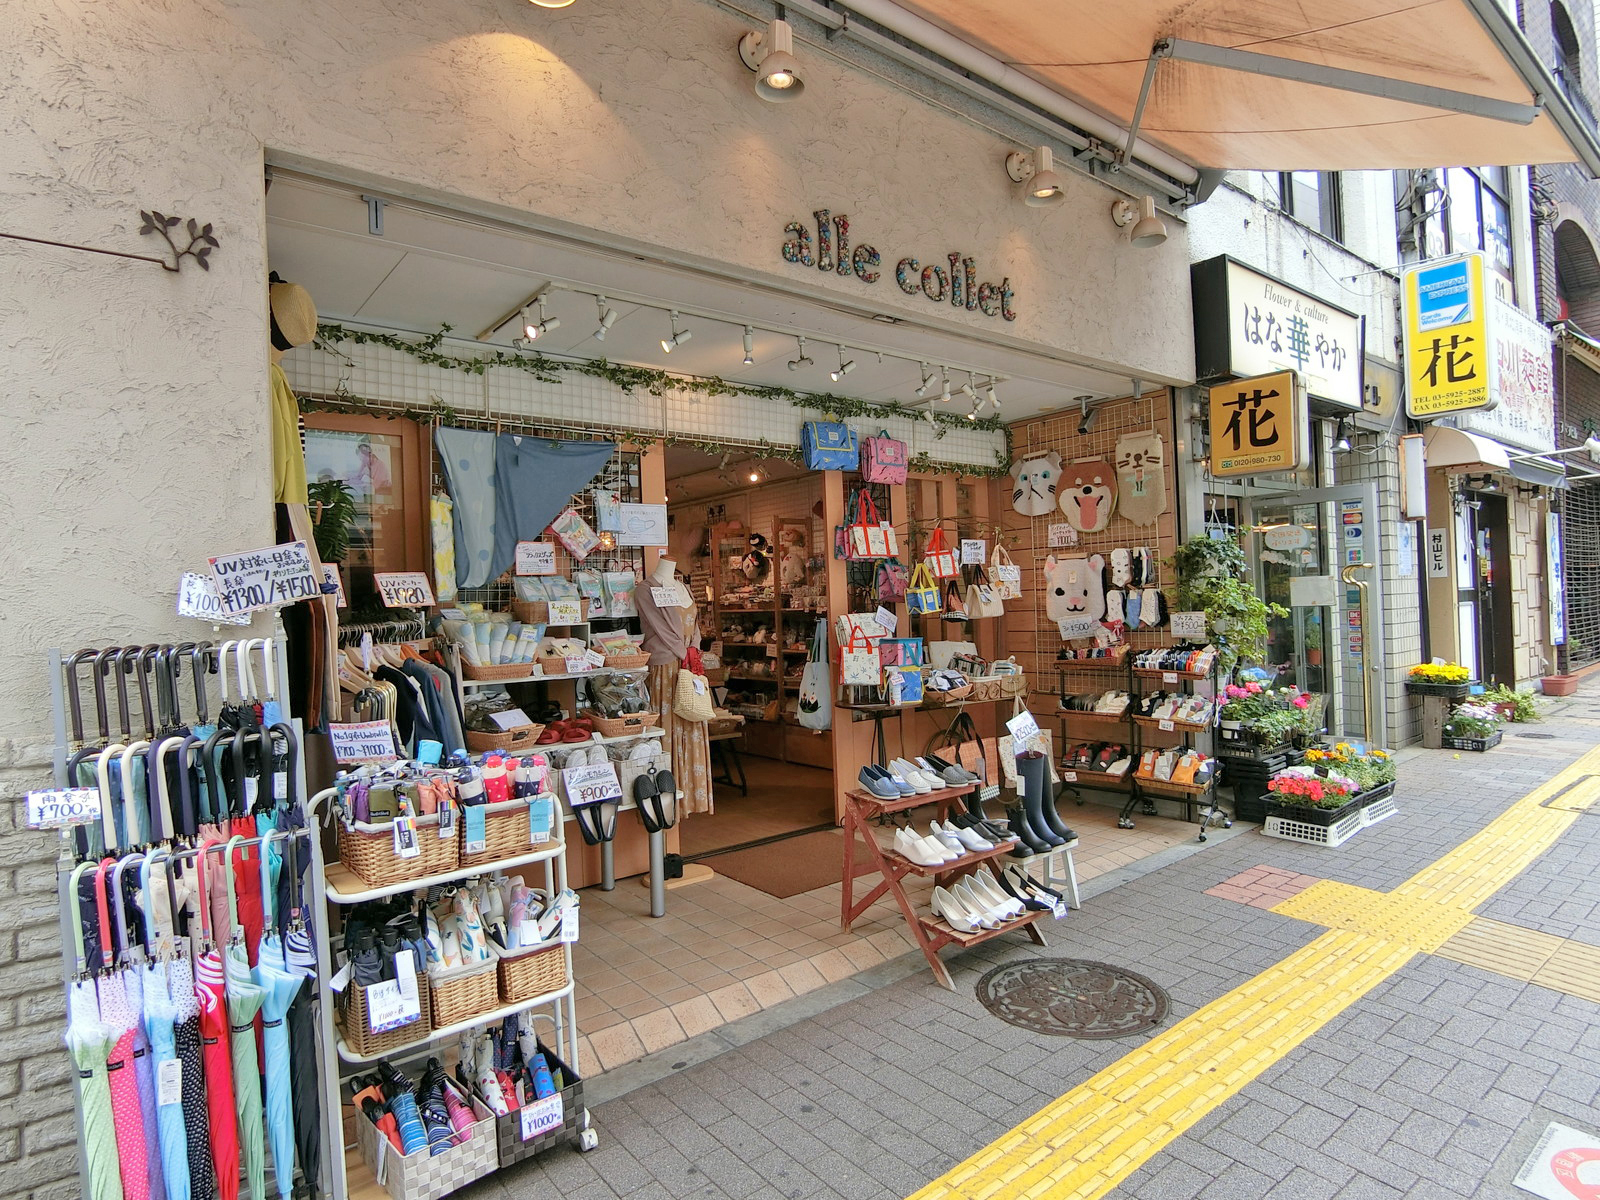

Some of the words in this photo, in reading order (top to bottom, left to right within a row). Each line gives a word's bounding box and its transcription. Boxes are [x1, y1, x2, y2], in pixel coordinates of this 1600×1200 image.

[781, 208, 882, 285] alle
[895, 251, 1017, 322] collet
[1420, 276, 1466, 293] AMERICAN
[1428, 284, 1469, 300] EXPRESS
[1264, 283, 1293, 309] Flower
[1294, 300, 1301, 313] &
[1304, 304, 1329, 325] culture
[1421, 312, 1441, 321] Cards
[1421, 315, 1454, 326] Welcome
[1243, 301, 1347, 373] はな華やか
[1418, 334, 1477, 388] 花
[1413, 404, 1431, 412] FAX
[1432, 395, 1486, 409] 03-5925-2886
[1415, 396, 1431, 404] TEL
[1432, 386, 1486, 401] 03-5925-2887
[1222, 389, 1280, 451] 花
[1431, 533, 1444, 571] 村山ビル
[221, 583, 264, 613] ¥1300
[383, 587, 425, 604] ¥1980
[579, 784, 608, 803] ¥900
[37, 803, 83, 820] ¥700
[527, 1112, 554, 1133] ¥1000
